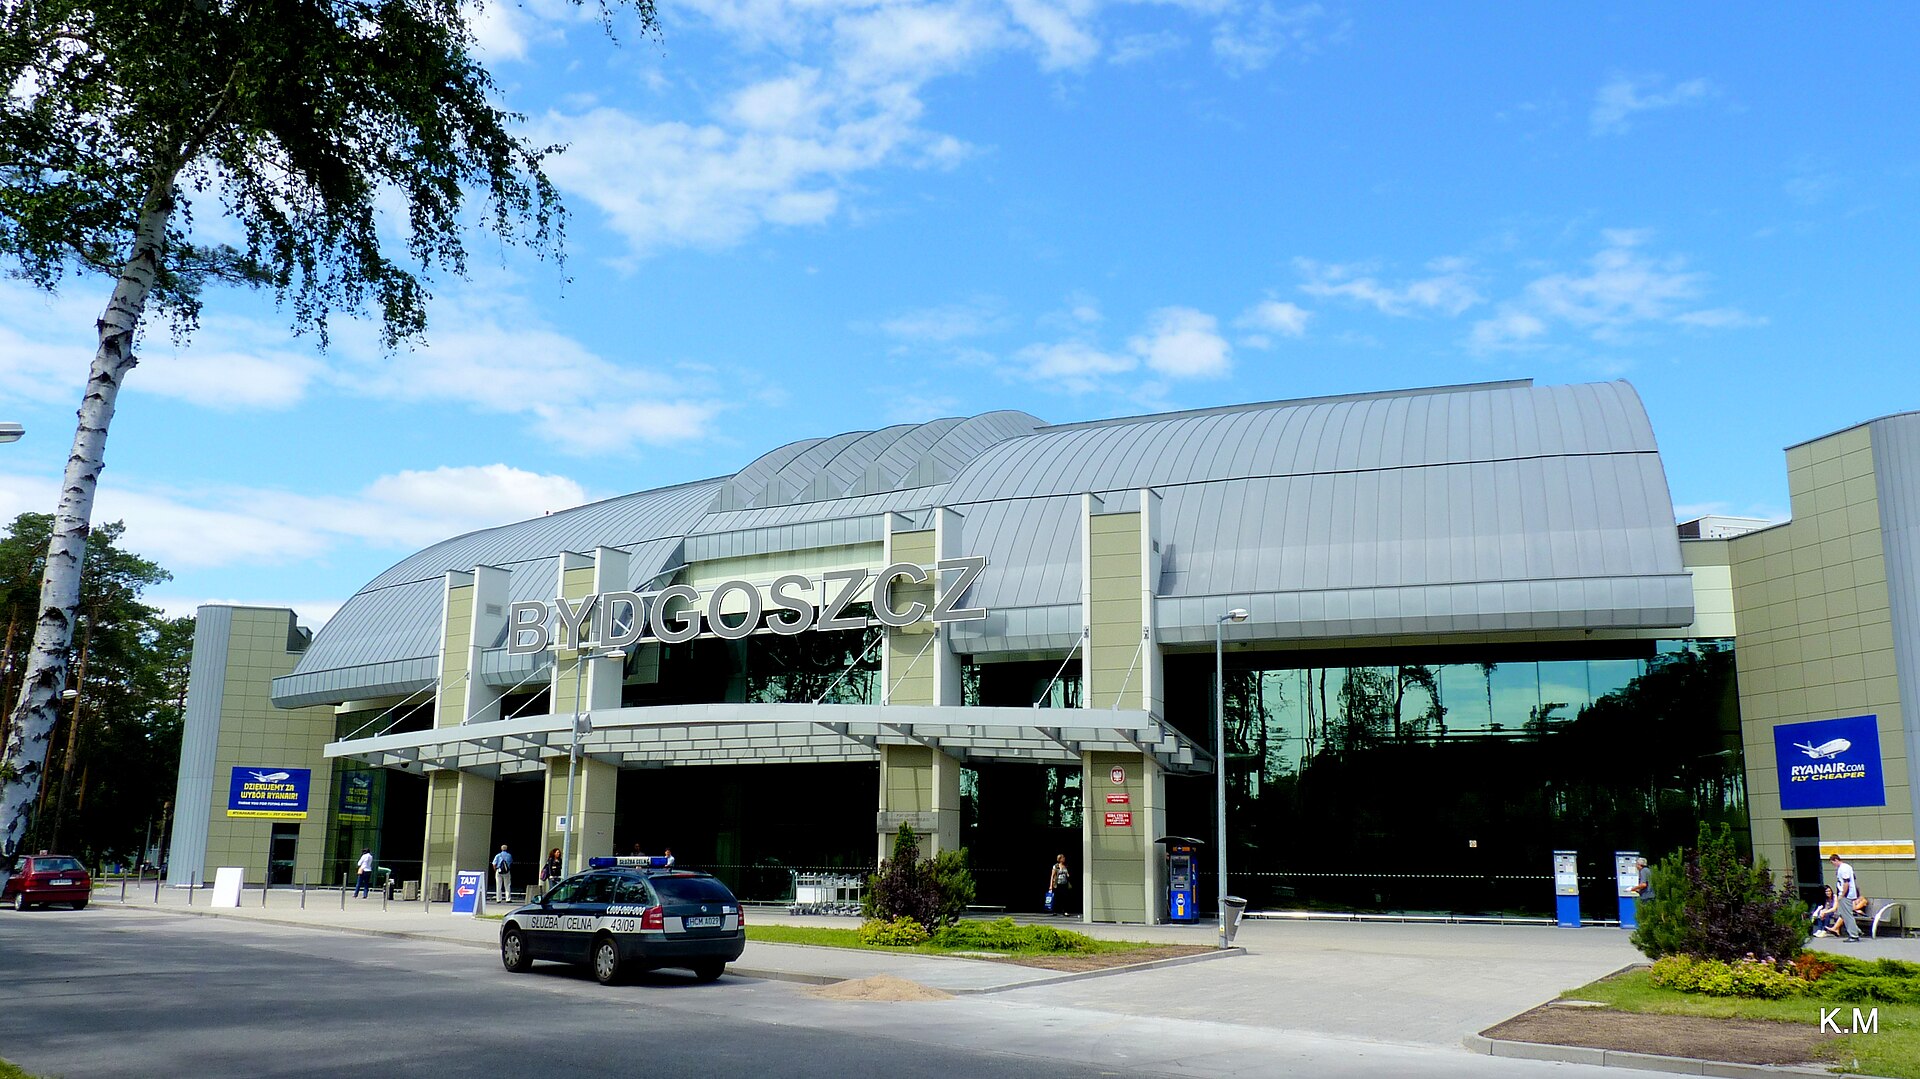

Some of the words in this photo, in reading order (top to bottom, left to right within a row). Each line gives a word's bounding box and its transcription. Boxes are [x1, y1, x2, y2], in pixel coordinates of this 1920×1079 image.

[507, 555, 988, 656] BYDGOSZCZ
[1791, 762, 1865, 776] RYANAIR.COM
[1811, 771, 1866, 781] CHEAPER
[244, 783, 284, 791] DZIĘKUJEMY
[241, 791, 265, 799] WYBÓR
[460, 876, 476, 885] TAXI
[531, 915, 559, 929] SŁUŻBA
[566, 917, 593, 930] CELNA
[611, 919, 635, 932] 43/09
